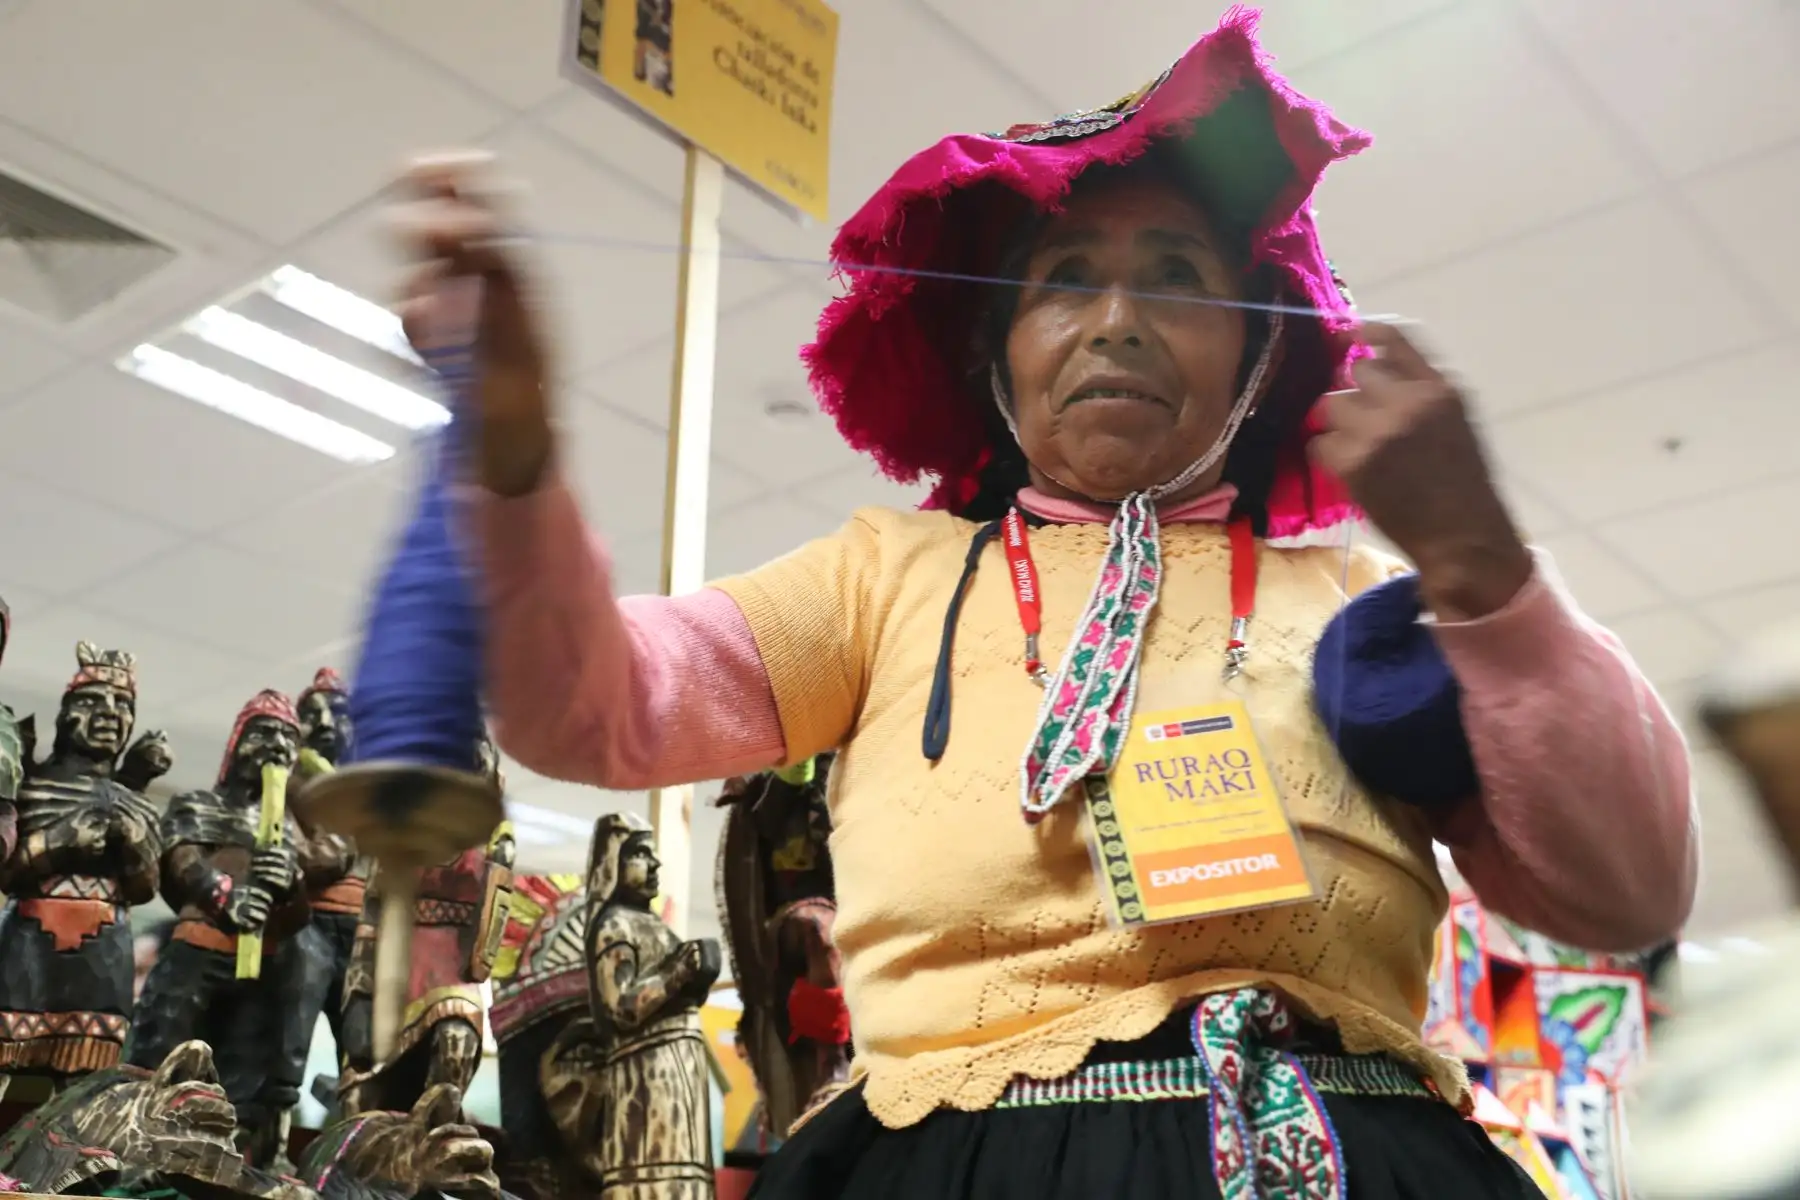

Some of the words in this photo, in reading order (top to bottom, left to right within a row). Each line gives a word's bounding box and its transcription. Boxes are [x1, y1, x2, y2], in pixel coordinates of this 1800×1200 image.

[1134, 748, 1251, 783] RURAQ
[1164, 770, 1257, 802] MAKI
[1150, 853, 1280, 888] EXPOSITOR
